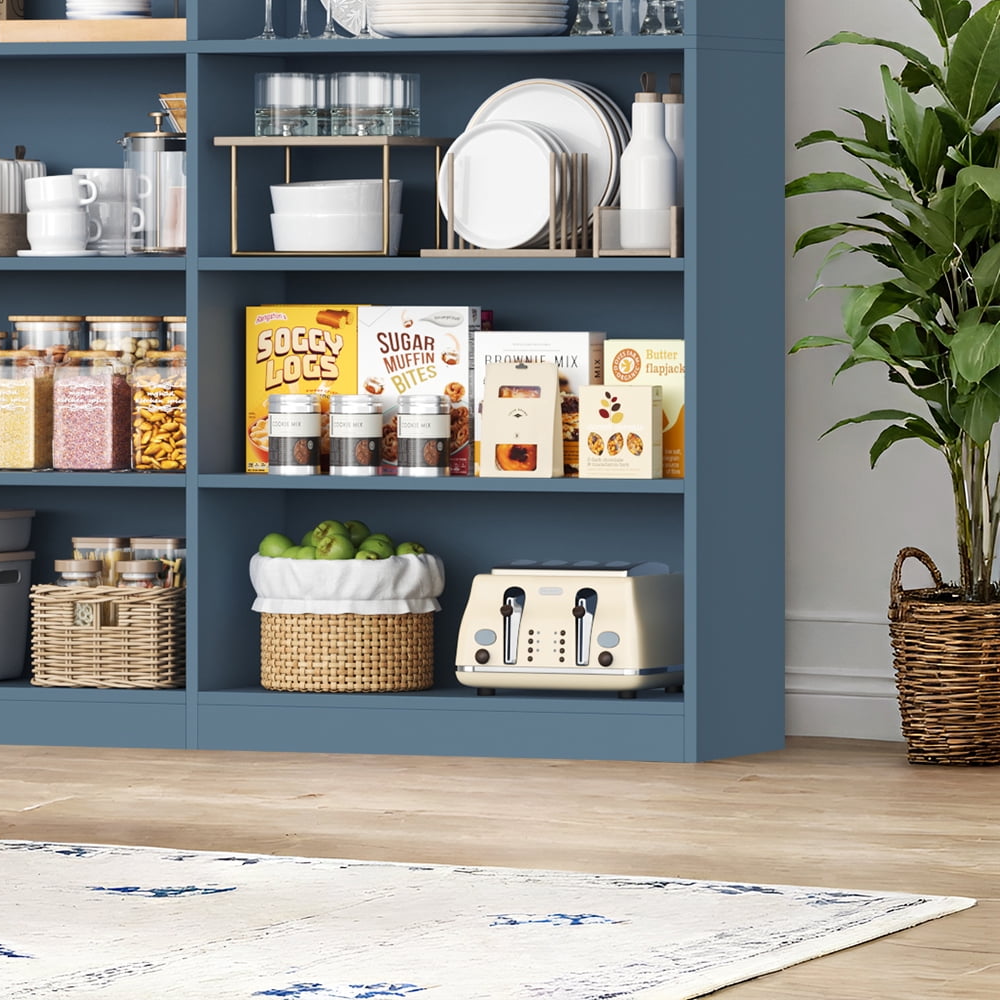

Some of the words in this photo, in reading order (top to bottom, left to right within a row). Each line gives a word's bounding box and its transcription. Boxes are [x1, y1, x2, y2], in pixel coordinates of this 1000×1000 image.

[256, 326, 344, 364] SOGGY
[376, 332, 435, 354] SUGAR
[382, 352, 435, 374] MUFFIN
[554, 354, 578, 368] MIX
[646, 349, 678, 360] Butter
[265, 354, 339, 391] LOGS
[390, 365, 437, 394] BITES
[645, 363, 686, 376] flapjack
